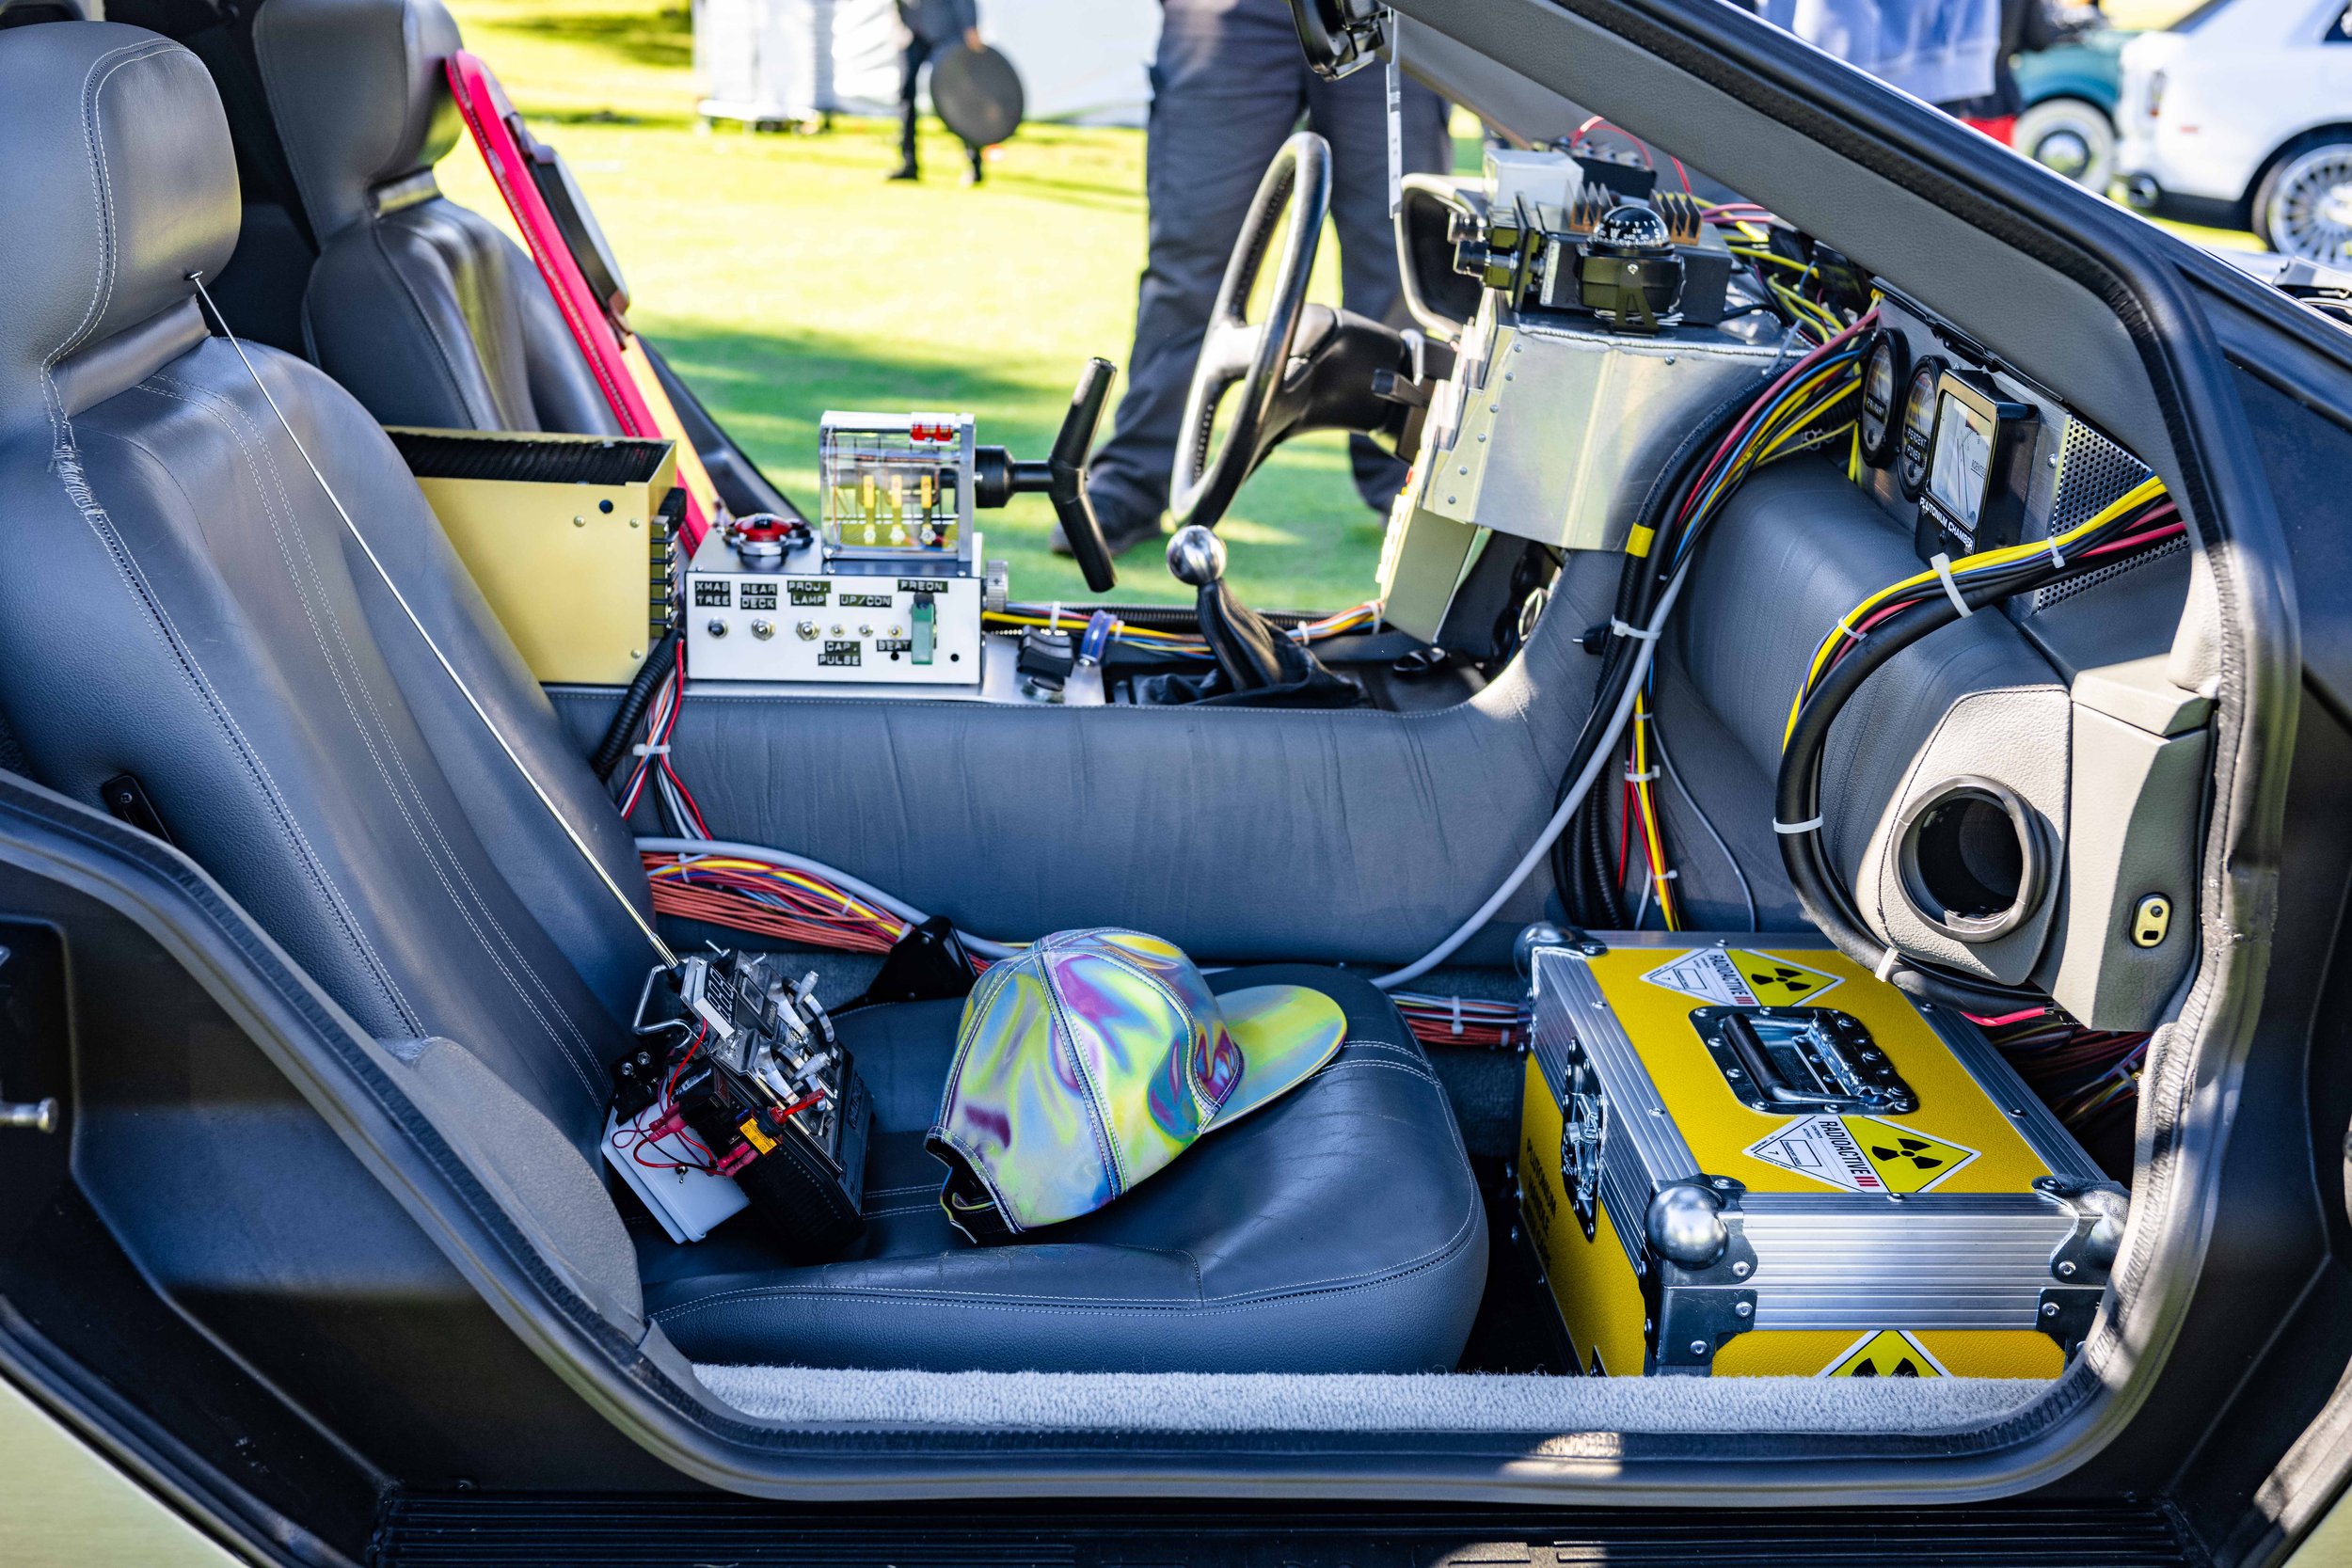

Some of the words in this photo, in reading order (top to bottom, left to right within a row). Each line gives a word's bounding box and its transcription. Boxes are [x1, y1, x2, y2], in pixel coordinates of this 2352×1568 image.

[1611, 228, 1621, 238] W
[1654, 228, 1661, 239] S
[1947, 521, 1974, 550] CHAMBER
[696, 582, 730, 592] XMAS
[742, 584, 776, 594] REAR
[787, 581, 828, 592] PROJ.
[899, 580, 943, 591] FREON
[696, 594, 729, 605] TREE
[741, 598, 775, 609] DECK
[792, 594, 825, 605] LAMP
[840, 595, 891, 607] UP/CON
[826, 641, 858, 652] CAP.
[878, 641, 910, 651] BEAT
[818, 655, 860, 665] PULSE
[1708, 954, 1749, 995] RADIOACTIVE
[1818, 1120, 1872, 1175] RADIOACTIVE
